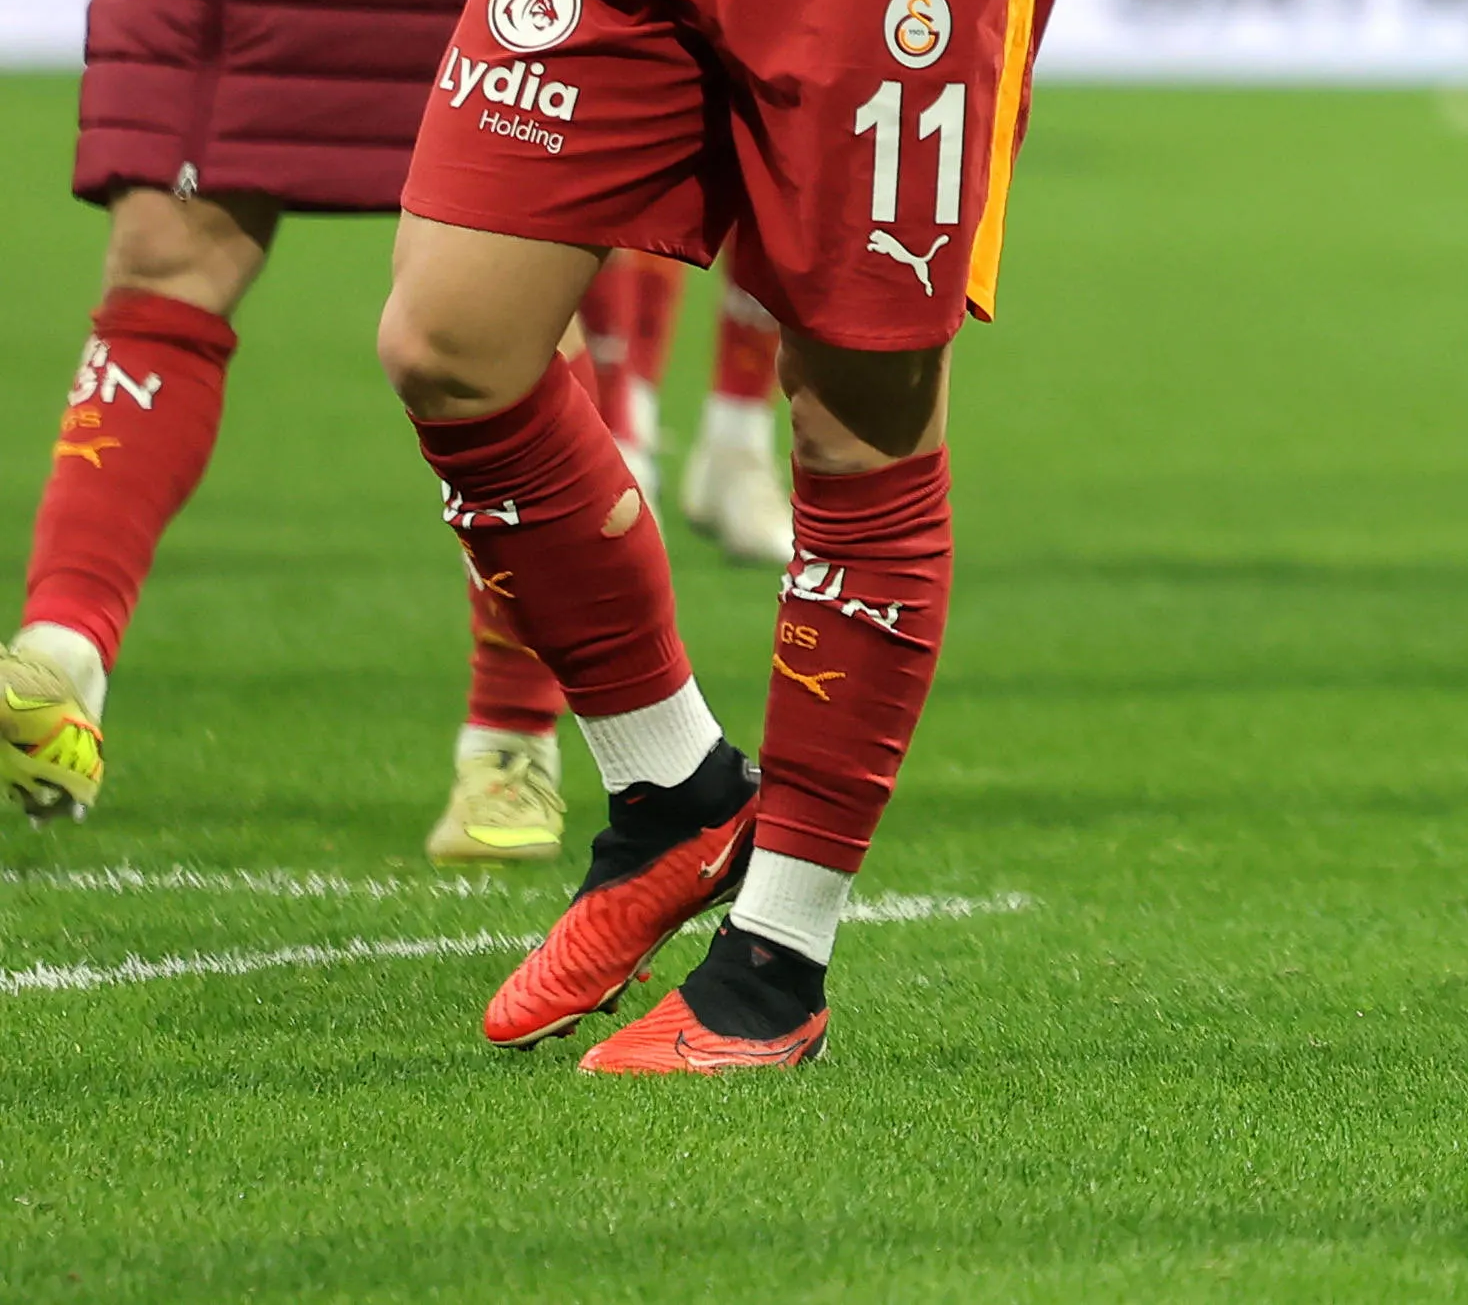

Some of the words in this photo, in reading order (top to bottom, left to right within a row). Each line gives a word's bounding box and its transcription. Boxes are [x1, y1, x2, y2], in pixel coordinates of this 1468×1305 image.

[438, 45, 580, 123] Lydia
[479, 109, 564, 154] Holding
[854, 80, 966, 225] 11
[781, 621, 820, 650] GS
